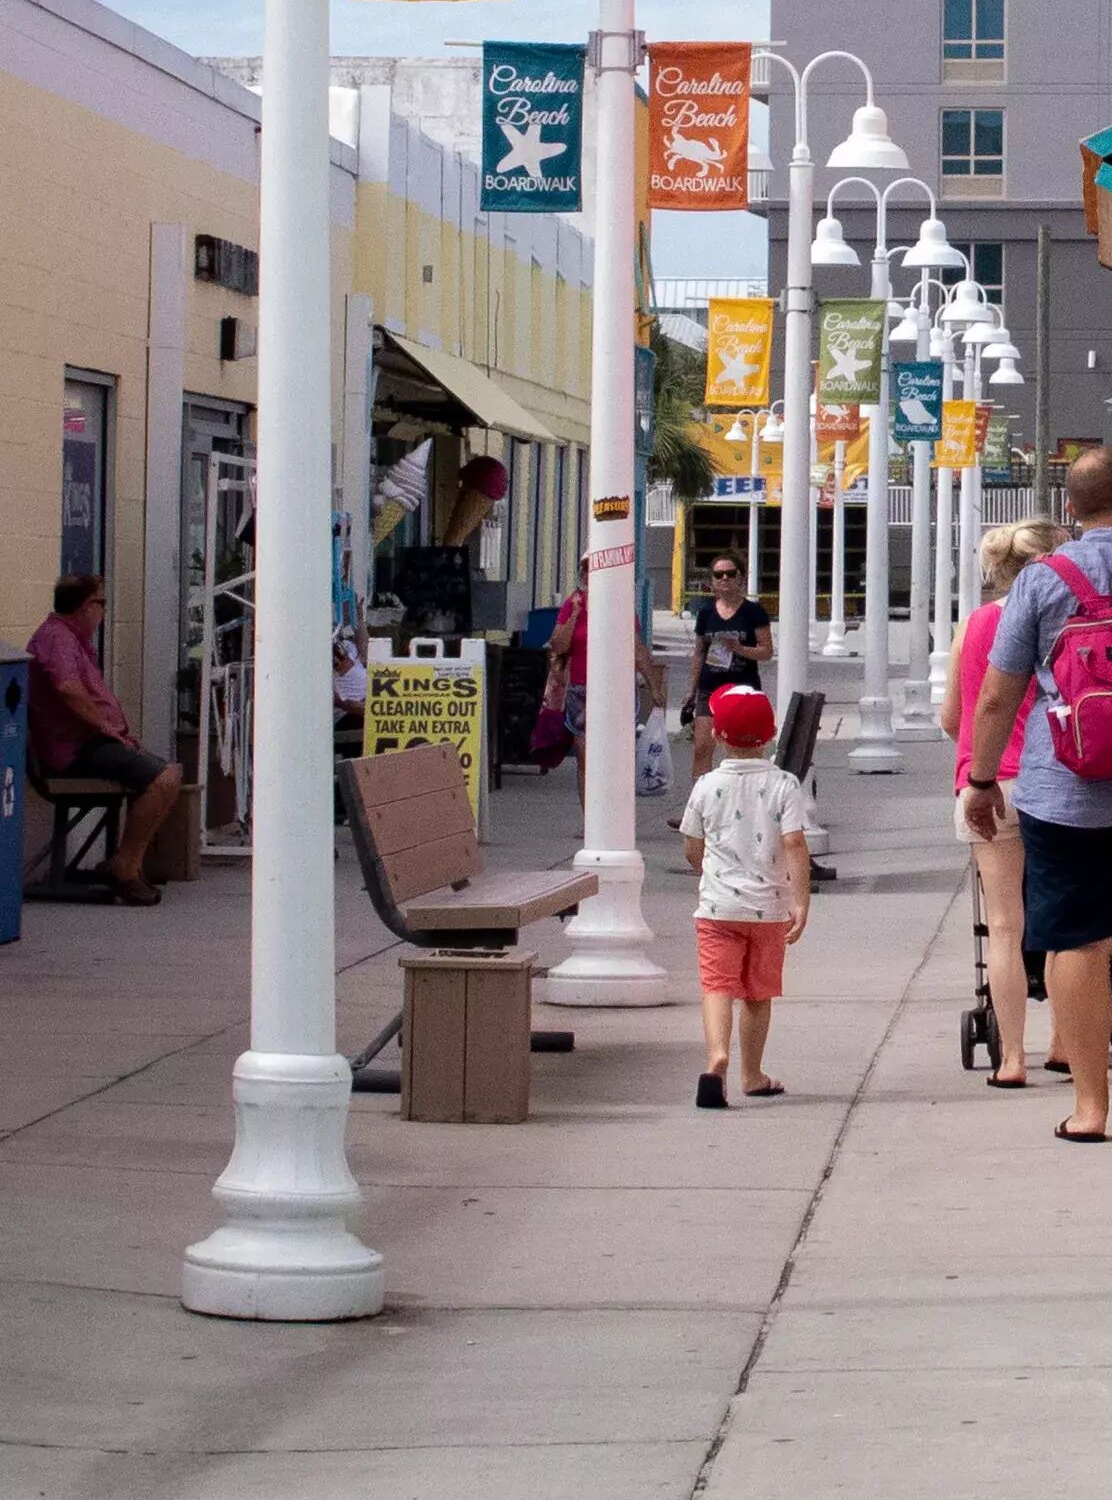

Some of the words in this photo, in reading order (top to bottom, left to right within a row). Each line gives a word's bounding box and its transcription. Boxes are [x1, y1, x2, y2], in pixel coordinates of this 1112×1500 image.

[489, 64, 578, 94] Carolina
[655, 65, 744, 97] Carolina
[496, 97, 570, 126] Beach
[662, 100, 738, 128] Beach
[485, 175, 577, 192] BOARDWALK
[651, 176, 742, 192] BOARDWALK
[823, 312, 882, 331] Carolina
[715, 333, 763, 354] Beach
[827, 331, 876, 351] Beach
[897, 371, 941, 387] Carolina
[900, 387, 938, 401] Beach
[371, 678, 478, 698] KINGS
[370, 700, 443, 717] CLEARING
[447, 700, 477, 717] OUT
[374, 719, 405, 734] TAKE
[408, 719, 428, 734] AN
[431, 719, 470, 734] EXTRA
